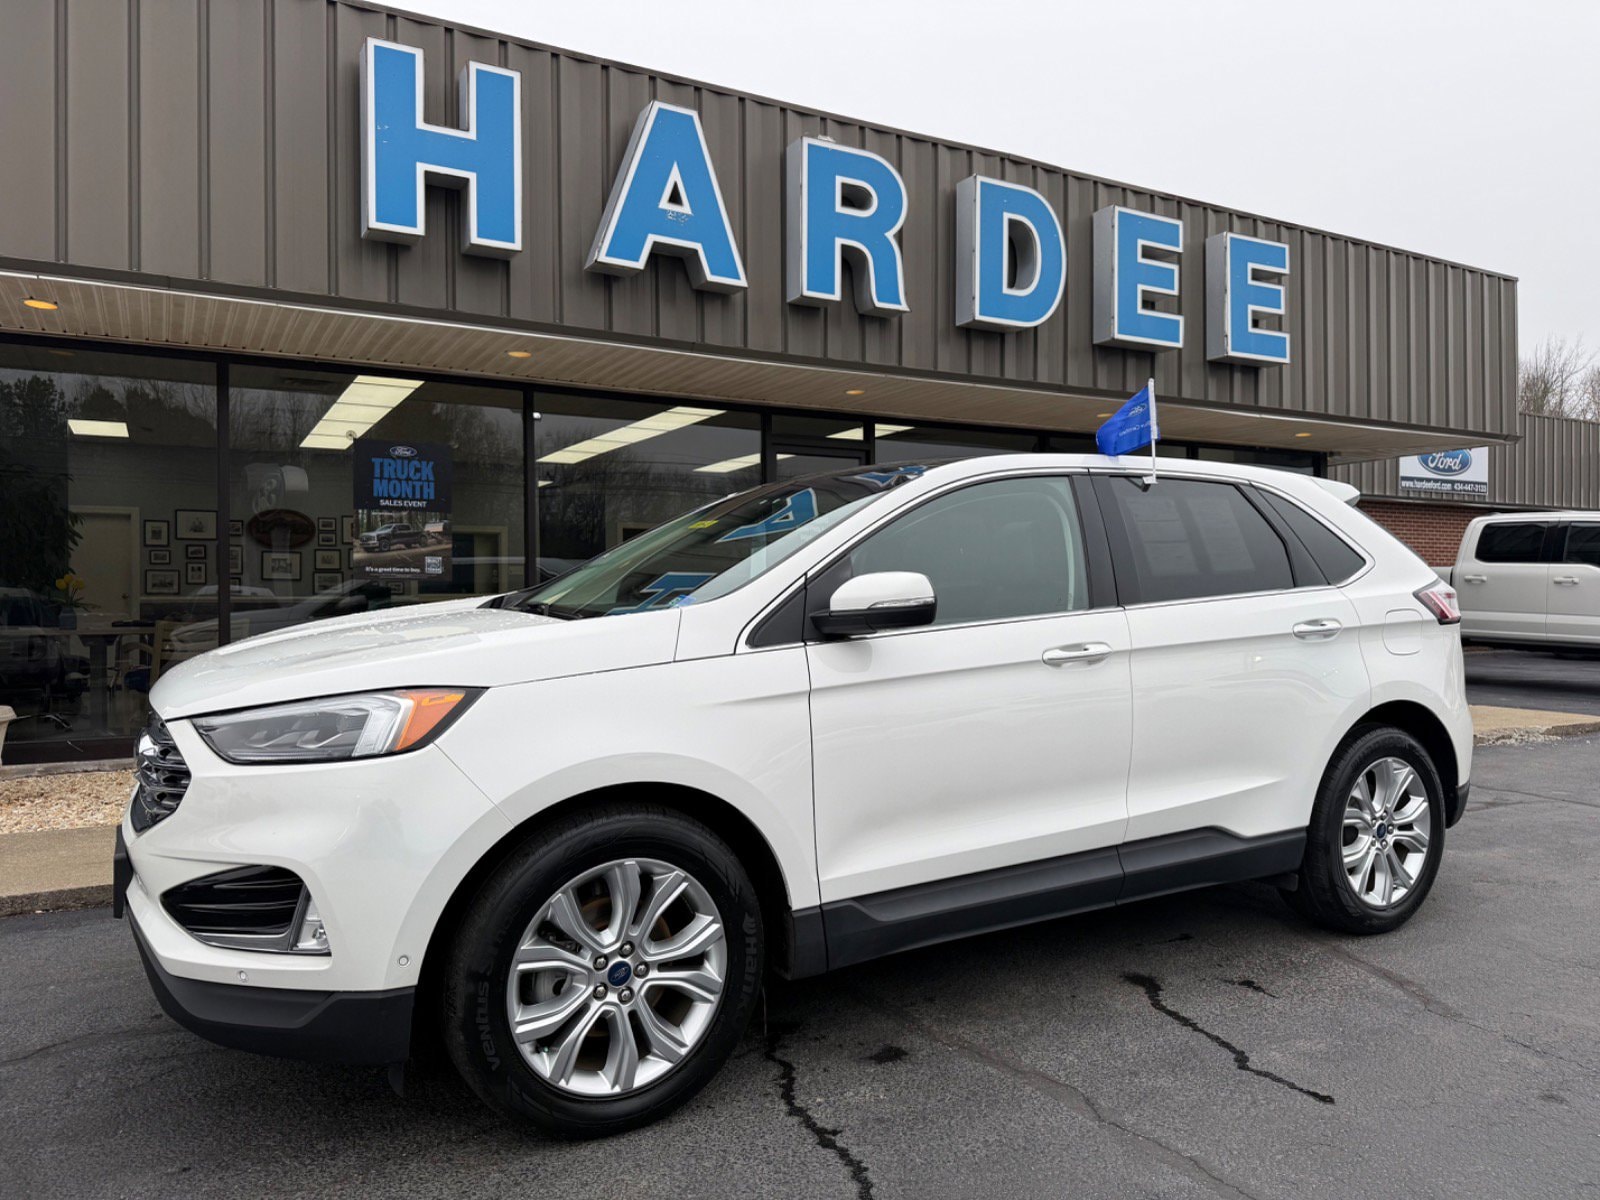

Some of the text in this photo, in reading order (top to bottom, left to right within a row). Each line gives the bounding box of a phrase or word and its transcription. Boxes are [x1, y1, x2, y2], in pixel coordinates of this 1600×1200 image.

[361, 37, 1291, 366] HARDEE
[372, 457, 435, 480] TRUCK
[1427, 452, 1462, 470] Ford
[373, 479, 435, 500] MONTH
[379, 499, 427, 508] SALES EVENT
